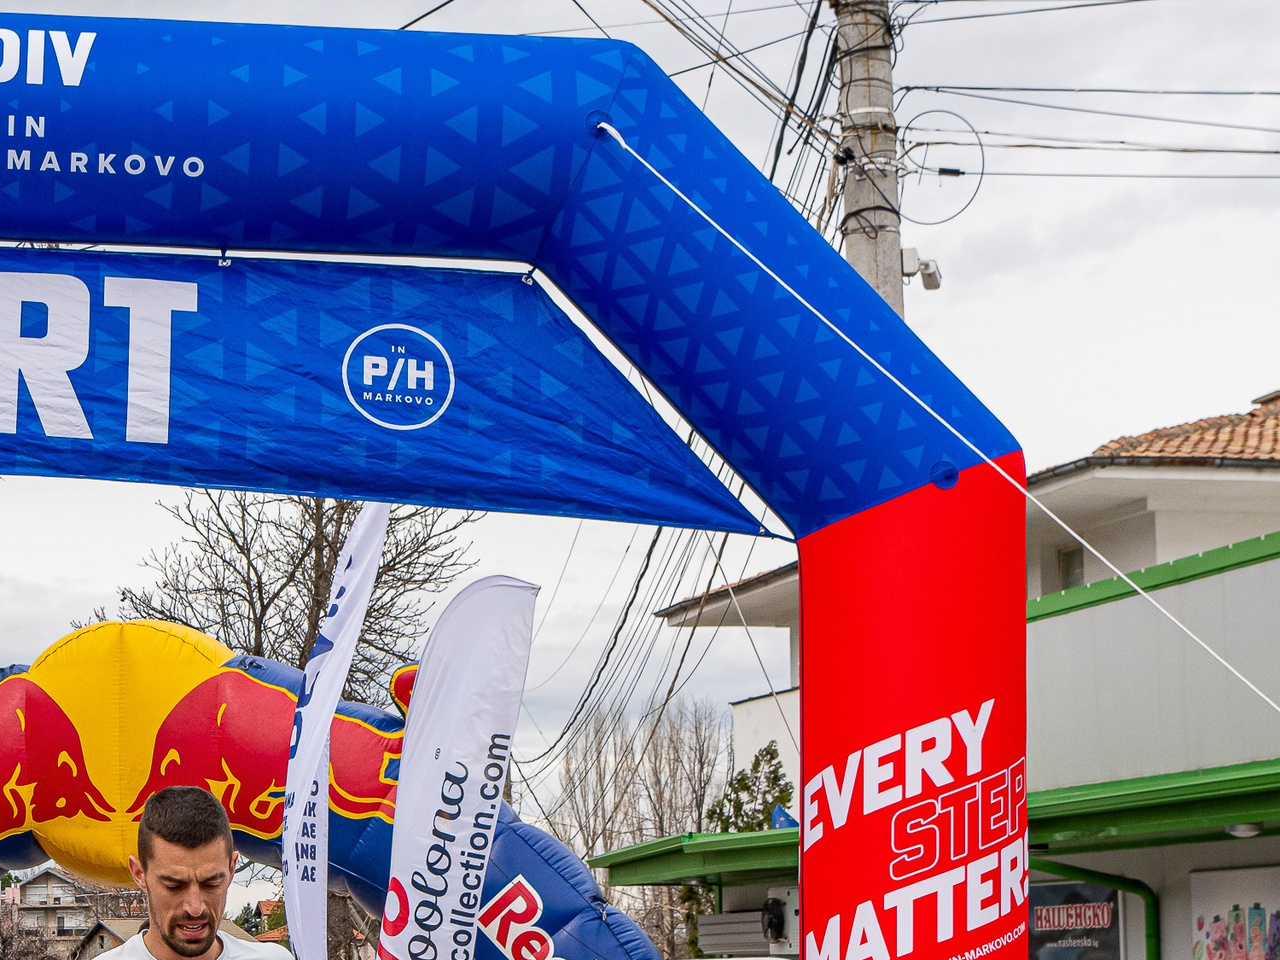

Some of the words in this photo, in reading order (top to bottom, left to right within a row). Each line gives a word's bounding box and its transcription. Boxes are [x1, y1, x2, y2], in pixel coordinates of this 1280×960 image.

[7, 115, 45, 138] IN
[6, 149, 205, 178] MARKOVO
[391, 345, 406, 354] IN
[363, 355, 434, 391] P/H
[363, 391, 434, 406] MARKOVO
[803, 698, 996, 853] EVERY
[889, 756, 1027, 882] STEP
[1034, 902, 1111, 931] НАШЕНСКО
